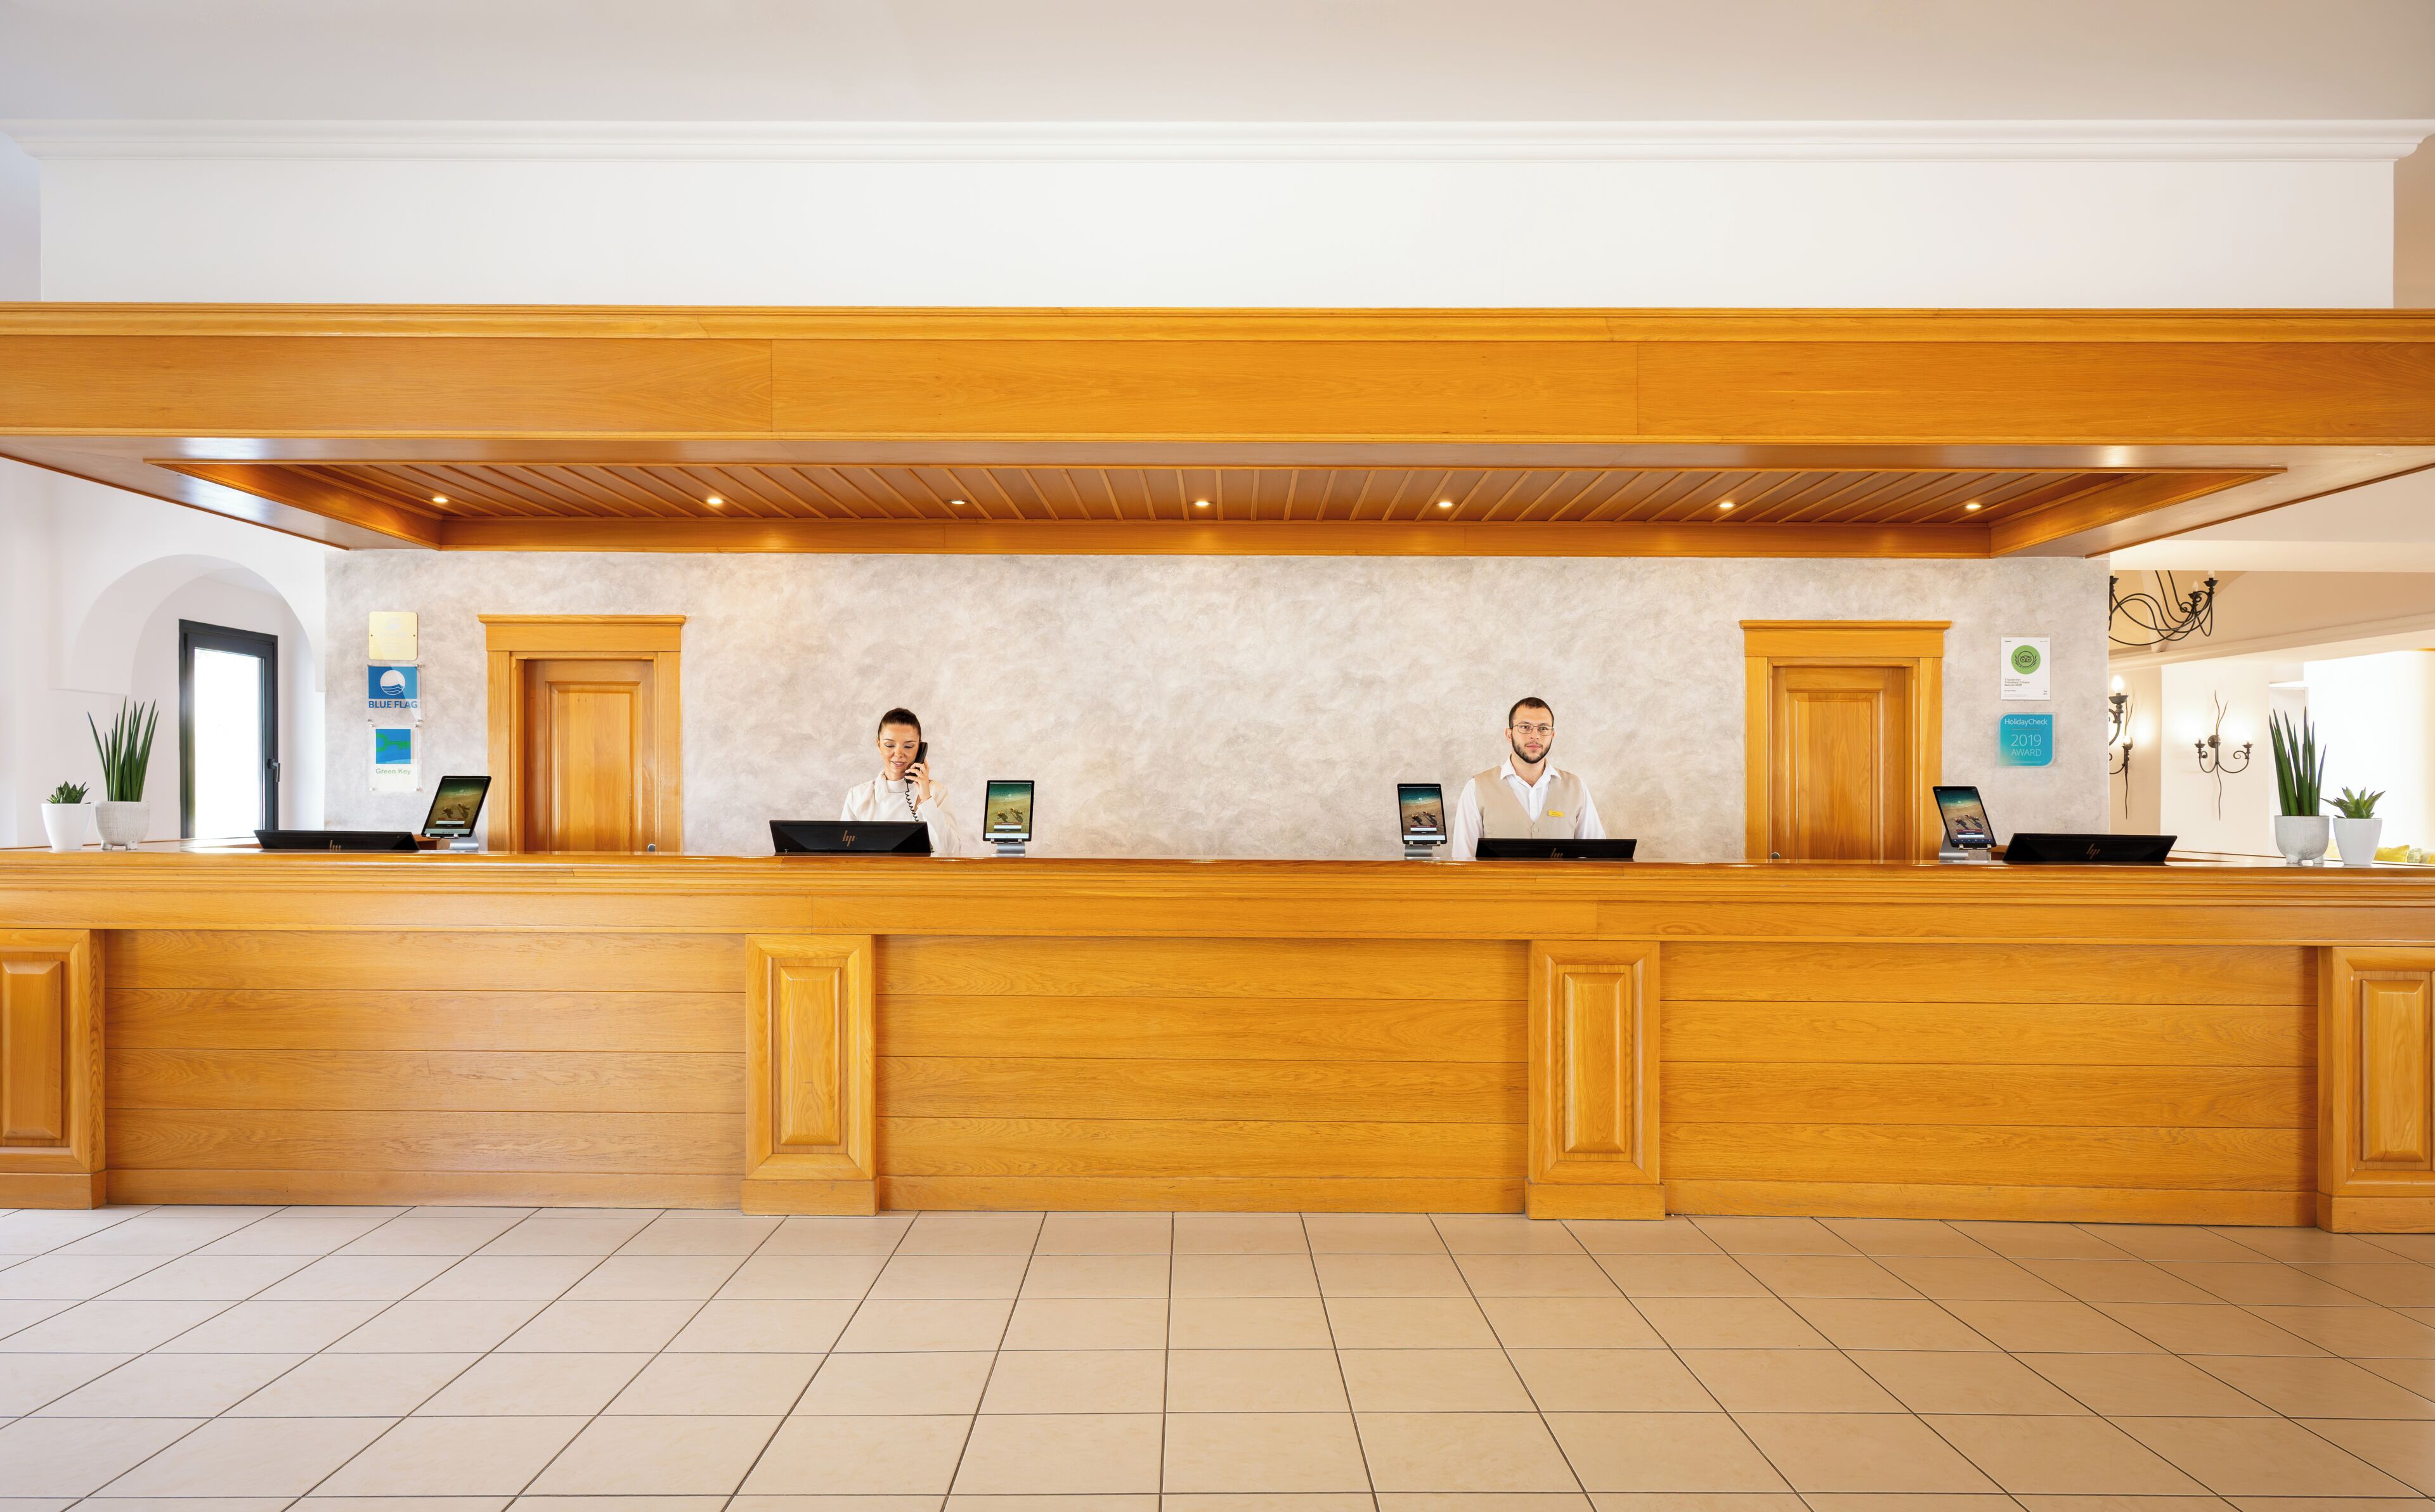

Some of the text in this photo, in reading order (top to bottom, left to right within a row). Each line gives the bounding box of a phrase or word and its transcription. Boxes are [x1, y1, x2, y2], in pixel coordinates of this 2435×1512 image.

[368, 701, 418, 709] BLUE FLAG
[2005, 718, 2048, 728] HolidayCheck
[2011, 734, 2042, 747] 2019
[842, 830, 855, 847] hp
[2086, 843, 2101, 860] hp
